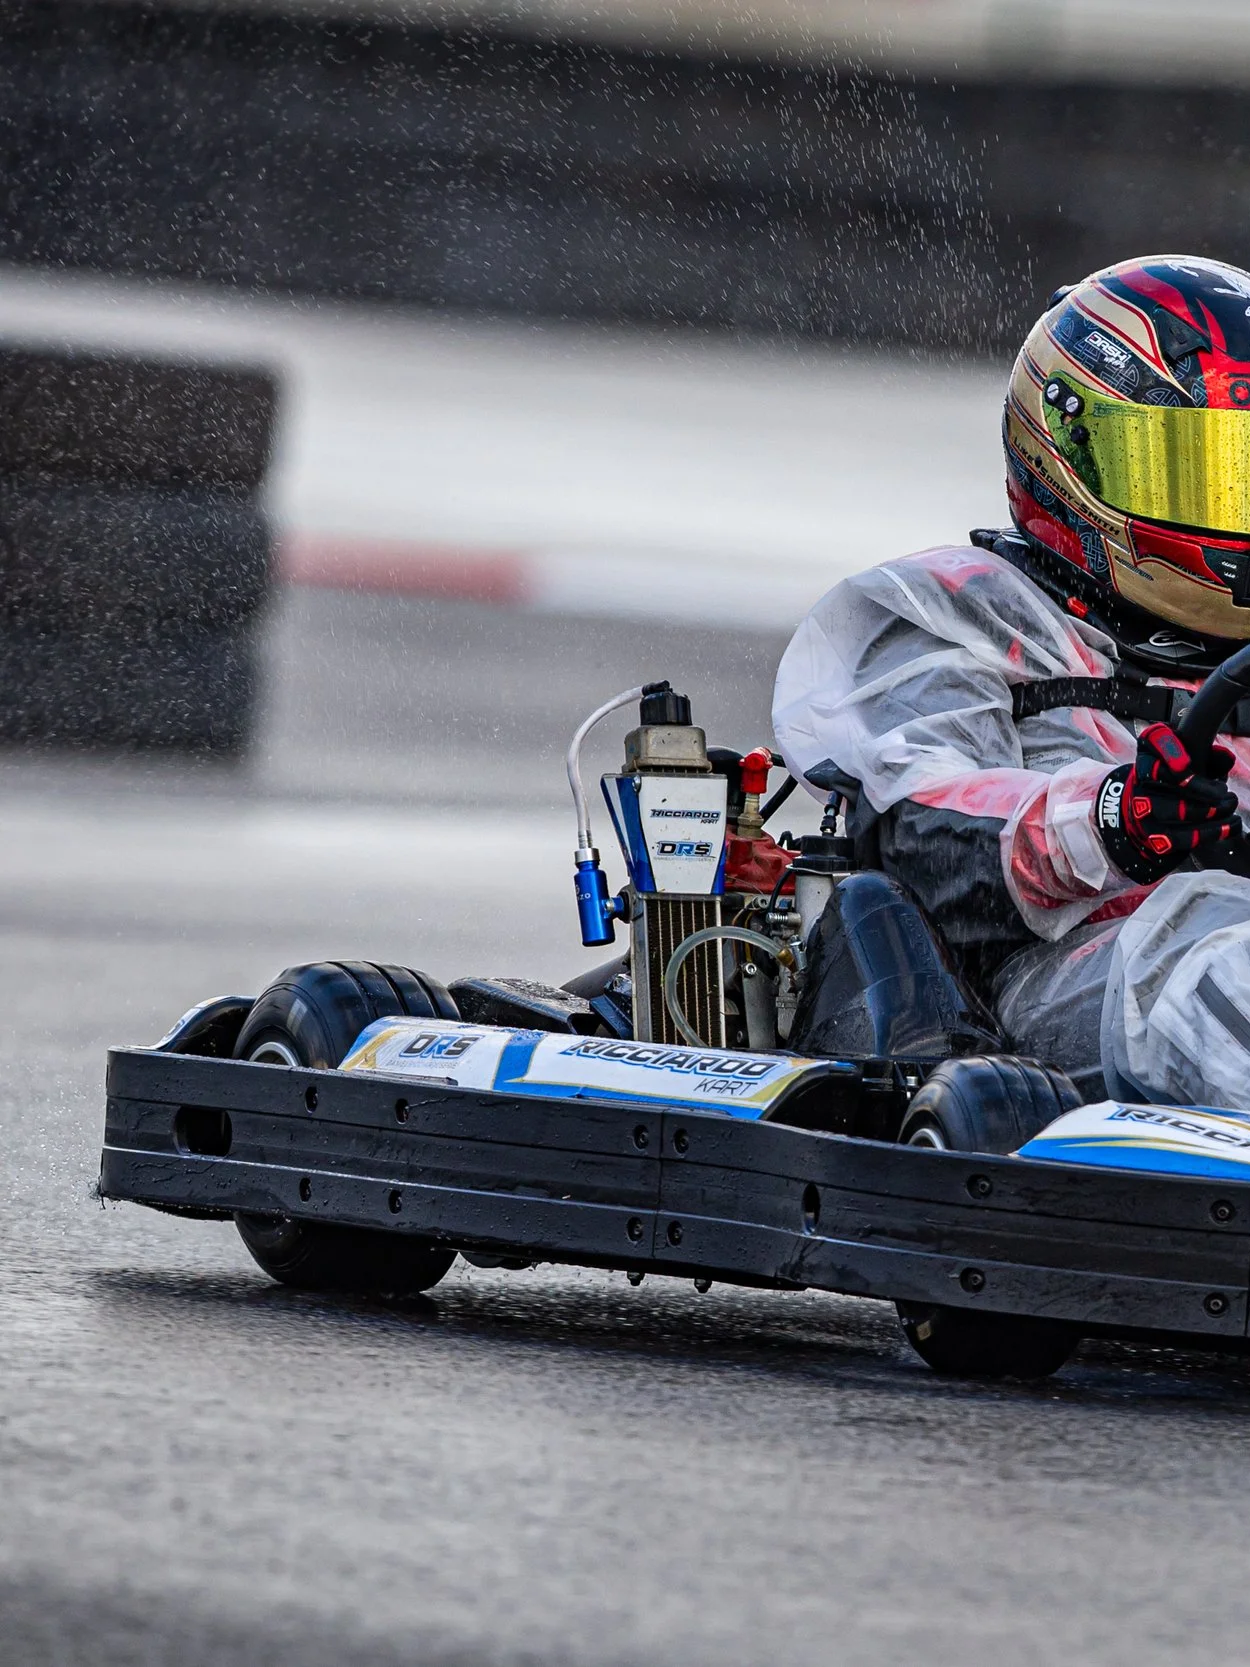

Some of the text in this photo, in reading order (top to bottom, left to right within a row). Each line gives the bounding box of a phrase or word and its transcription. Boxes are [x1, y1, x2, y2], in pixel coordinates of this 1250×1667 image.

[650, 809, 721, 819] RICCIARDO
[1103, 781, 1124, 828] OMP
[657, 841, 713, 857] DRS
[400, 1033, 483, 1059] DRS
[562, 1039, 783, 1079] RICCIARDO
[693, 1078, 758, 1096] KART
